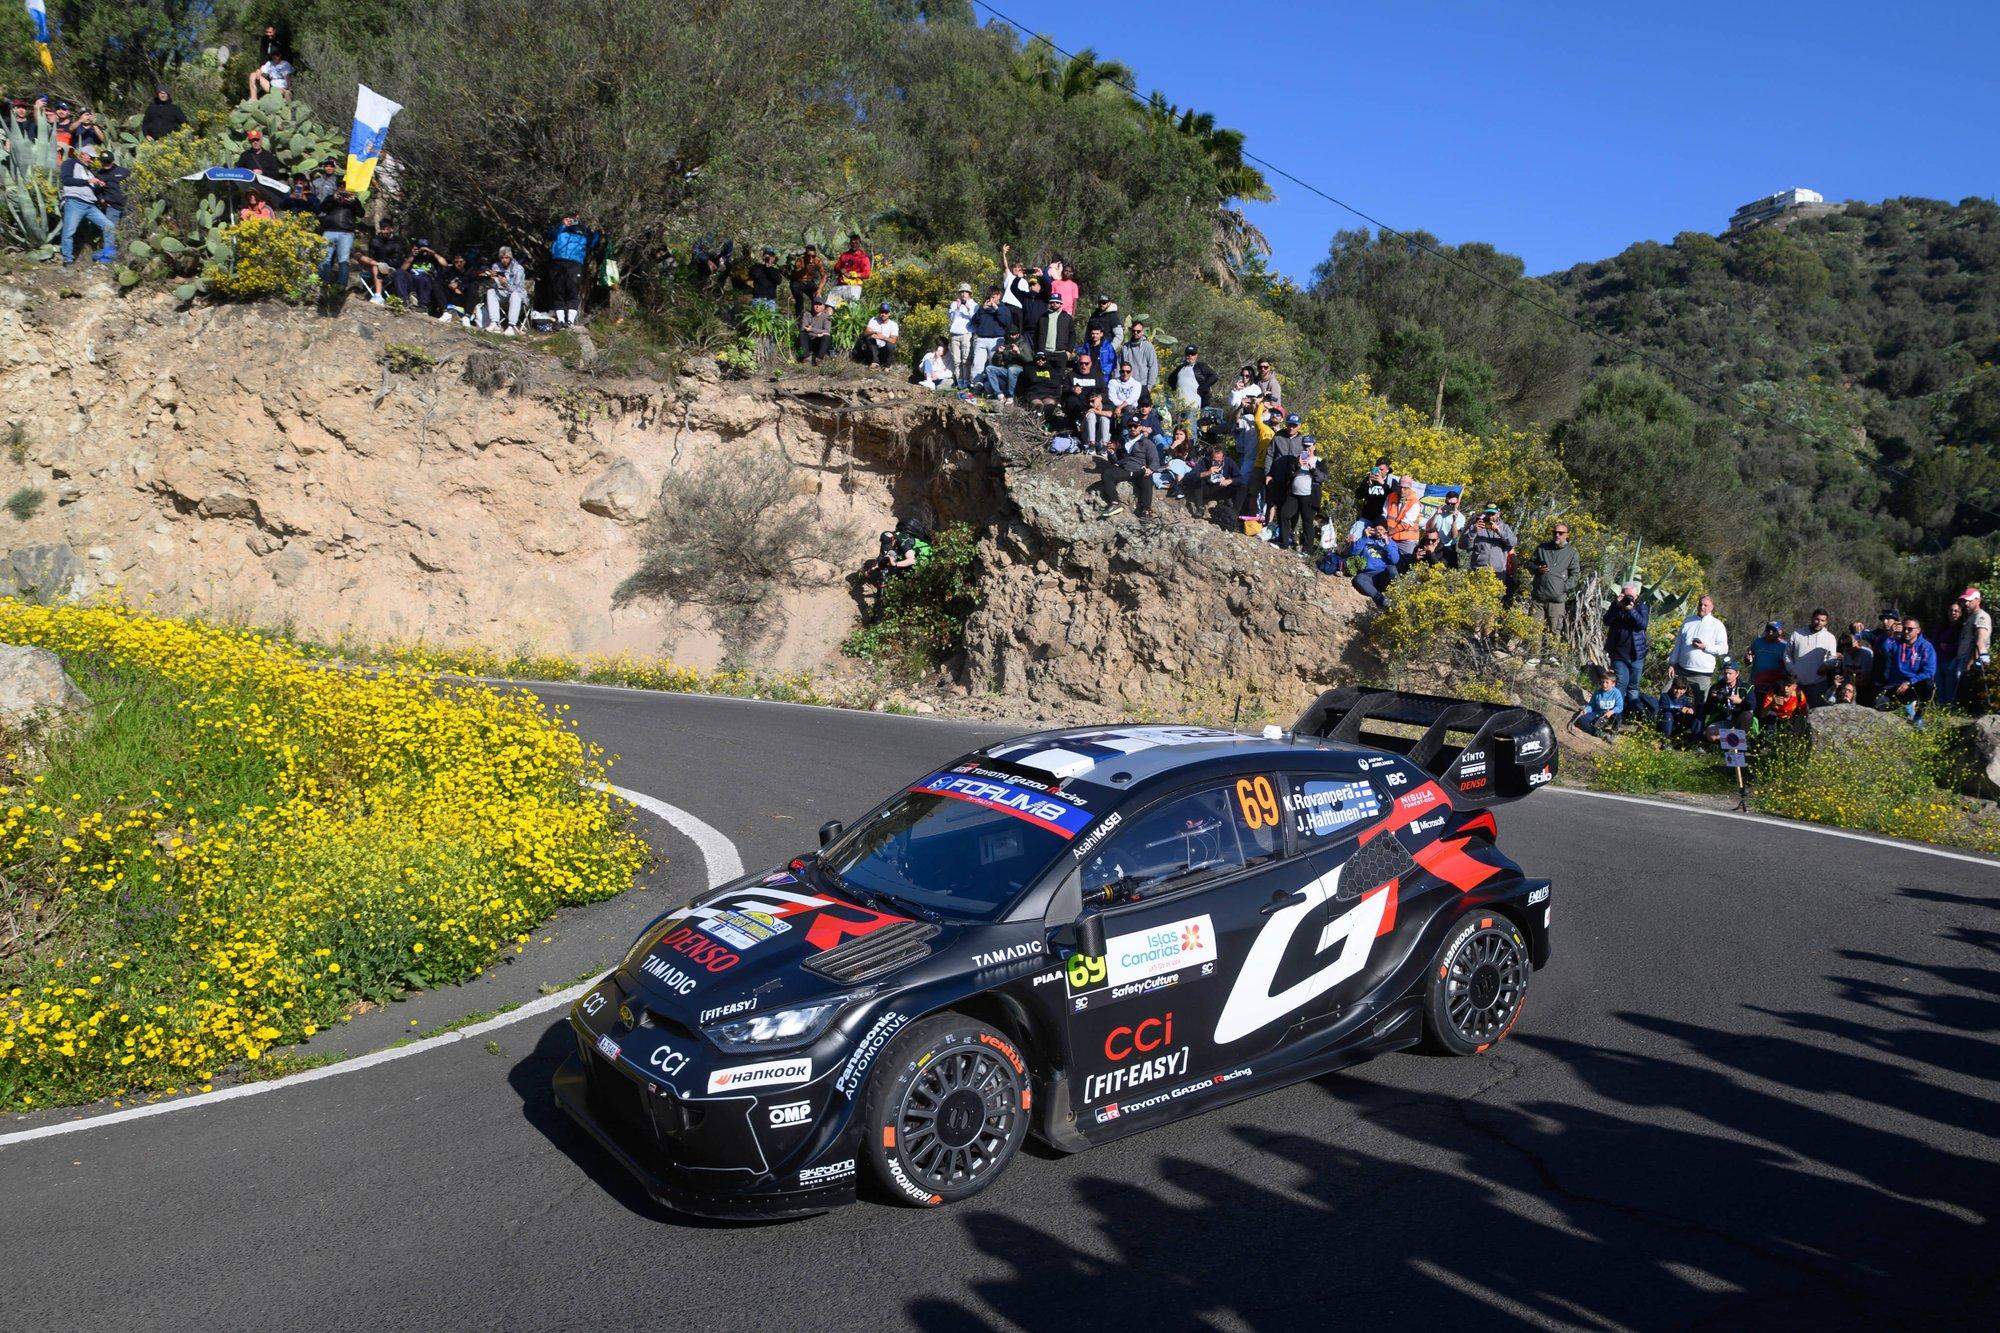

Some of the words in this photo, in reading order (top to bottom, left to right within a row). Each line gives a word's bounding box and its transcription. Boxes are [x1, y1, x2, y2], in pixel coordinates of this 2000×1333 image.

[1372, 759, 1394, 768] AIRLINES
[1462, 751, 1485, 763] KINTO
[971, 768, 1010, 780] TOYOTA
[1008, 775, 1049, 791] GAZOO
[1047, 786, 1088, 806] Racing
[1460, 777, 1487, 792] DENSO
[1529, 767, 1552, 786] Stilo
[948, 778, 1067, 821] FORUM8
[1235, 775, 1280, 830] 69
[1400, 789, 1434, 804] NISULA
[1297, 807, 1361, 832] J.Halttunen
[1420, 815, 1446, 831] Microsoft
[662, 927, 741, 973] DENSO
[1147, 930, 1179, 949] Islas
[972, 940, 1042, 967] TAMADIC
[1121, 942, 1180, 968] Canarias
[641, 954, 697, 996] TAMADIC
[1033, 970, 1064, 987] PIAA
[1067, 953, 1107, 988] 69
[1111, 972, 1179, 999] SafetyCulture
[835, 1011, 897, 1092] Panasonic
[845, 1014, 908, 1101] AUTOMOTIVE
[1121, 1093, 1170, 1114] TOYOTA
[1171, 1079, 1213, 1098] GAZOO
[1213, 1067, 1252, 1085] Racing
[769, 1104, 812, 1124] OMP
[800, 1178, 823, 1186] BRAKE
[827, 1170, 856, 1182] EXPERTS
